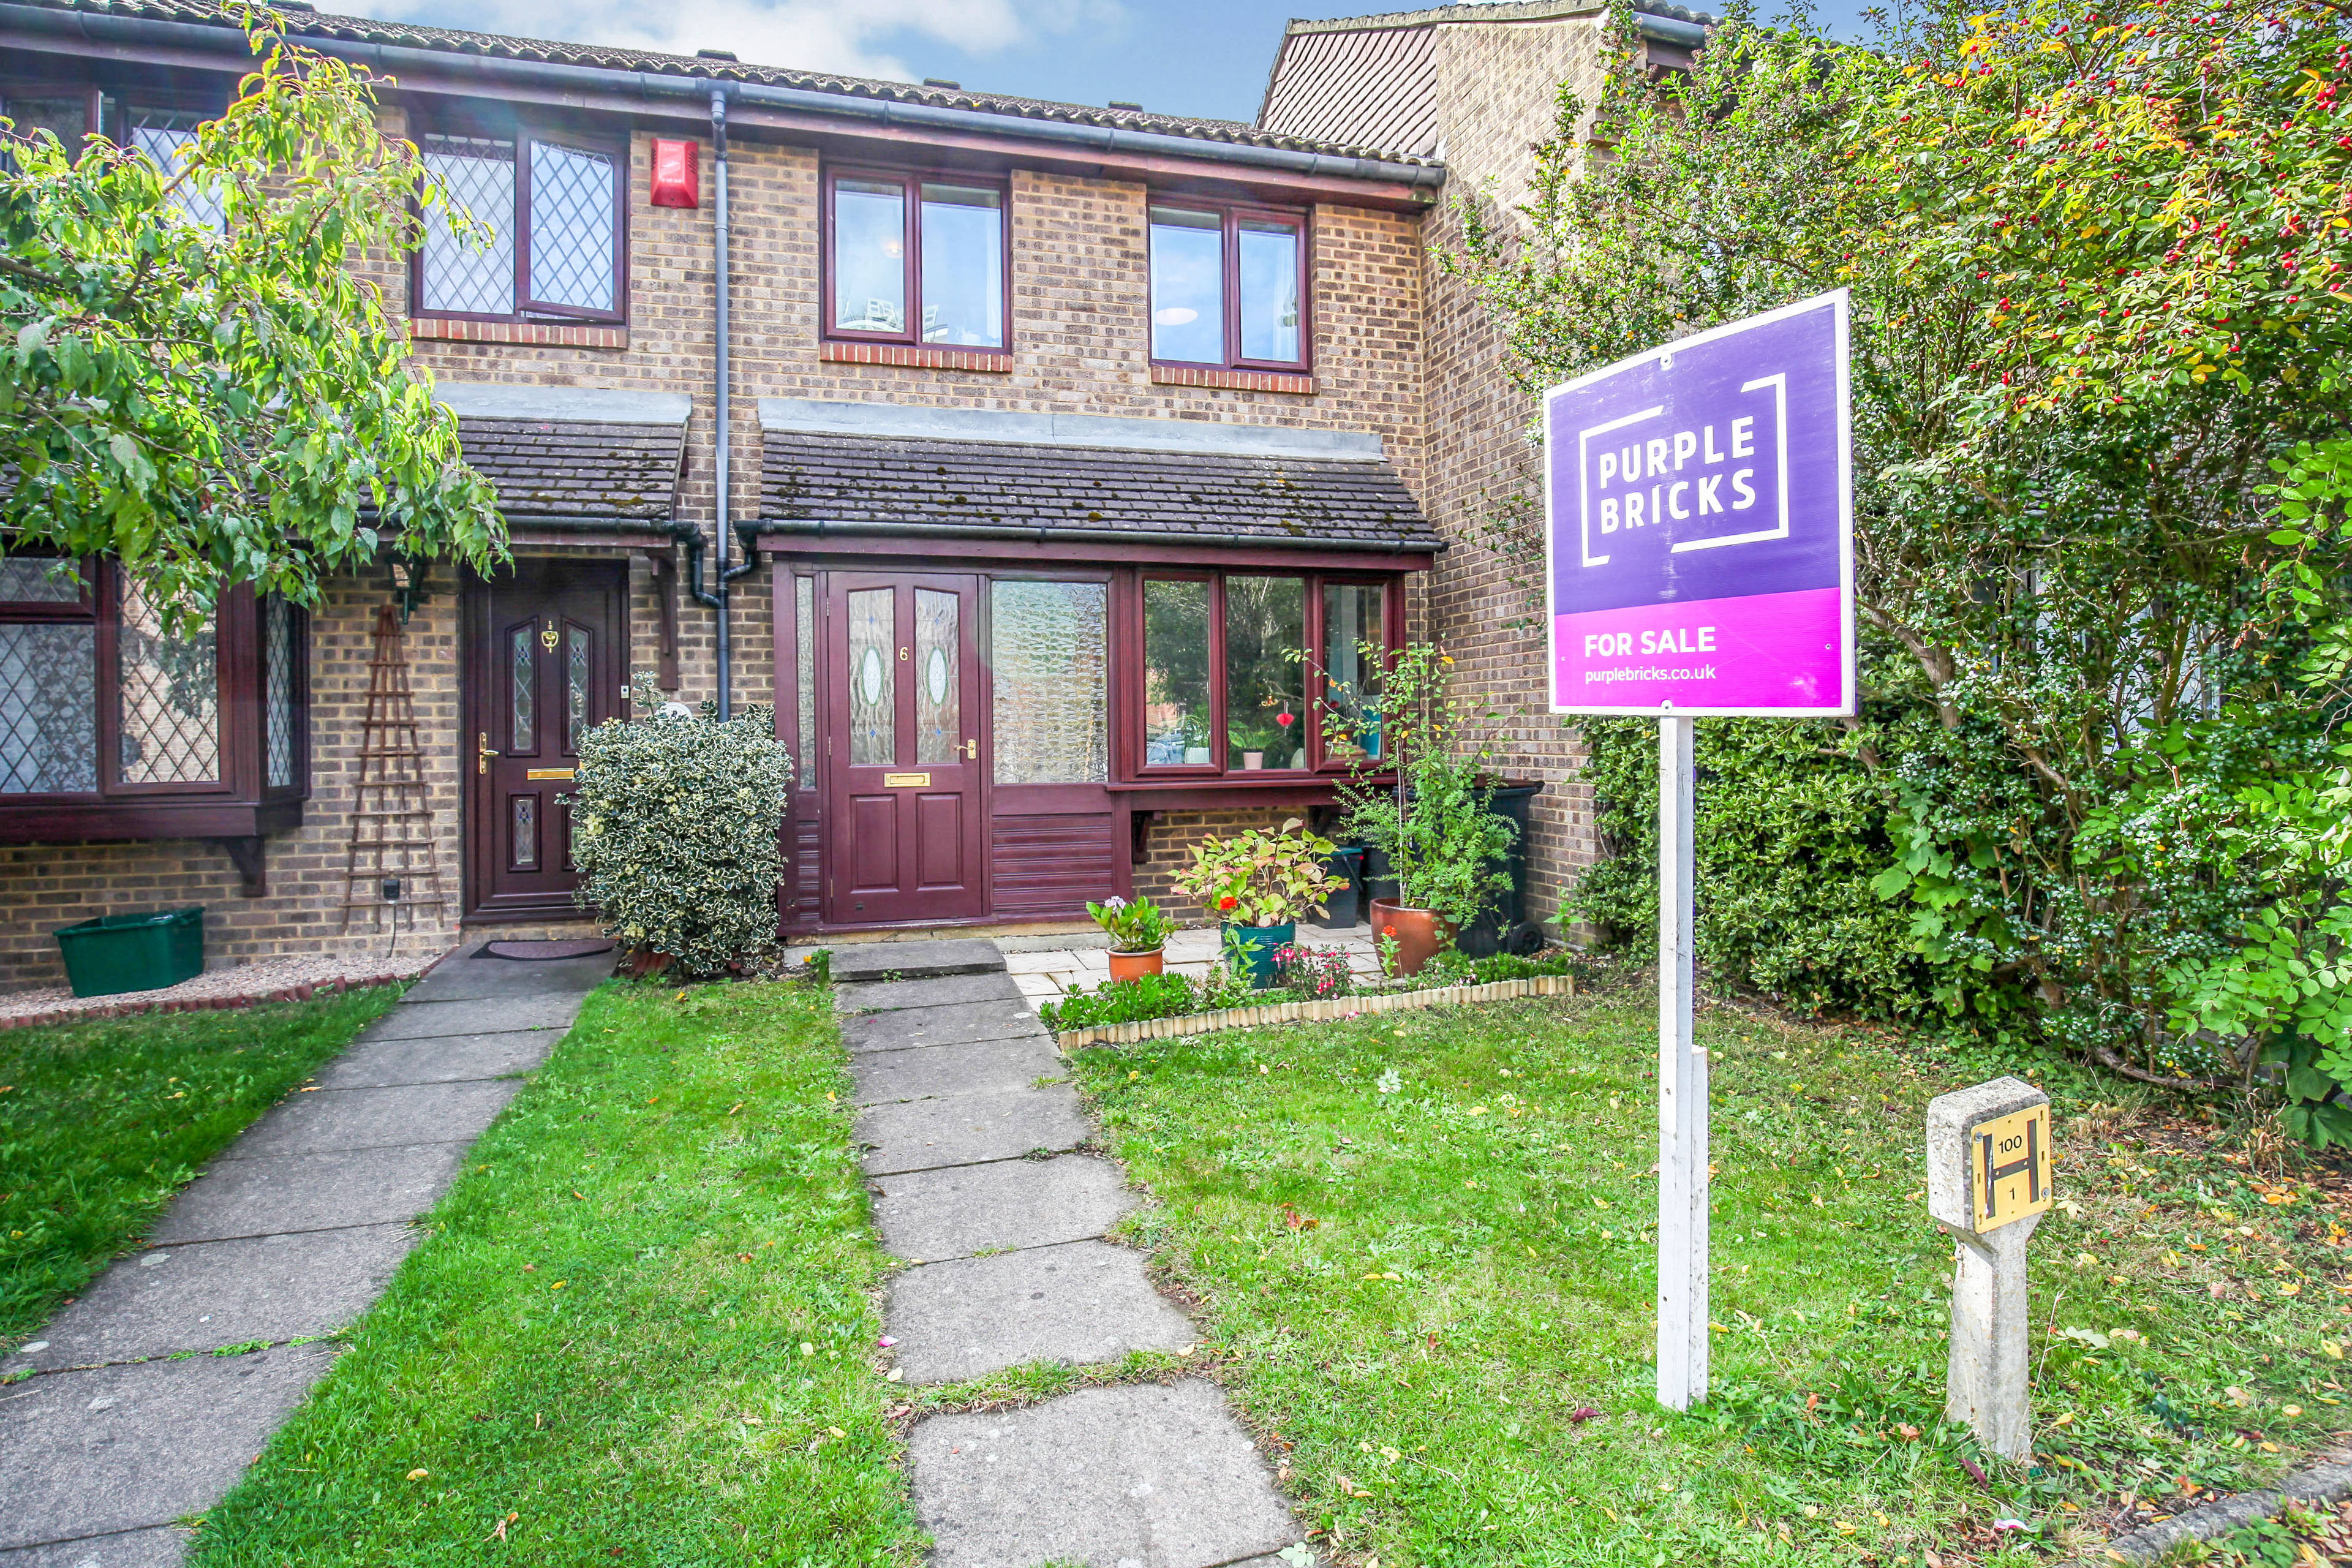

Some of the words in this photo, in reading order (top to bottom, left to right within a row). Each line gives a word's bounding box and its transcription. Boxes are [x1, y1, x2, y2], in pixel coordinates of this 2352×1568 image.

[1599, 415, 1755, 489] PURPLE
[1600, 468, 1756, 535] BRICKS
[899, 647, 908, 661] 6
[1585, 632, 1632, 657] FOR
[1640, 626, 1717, 655] SALE
[1585, 663, 1717, 685] purplebricks.co.uk
[1998, 1135, 2022, 1154] 100
[1983, 1118, 2040, 1219] H
[2009, 1187, 2015, 1200] 1
